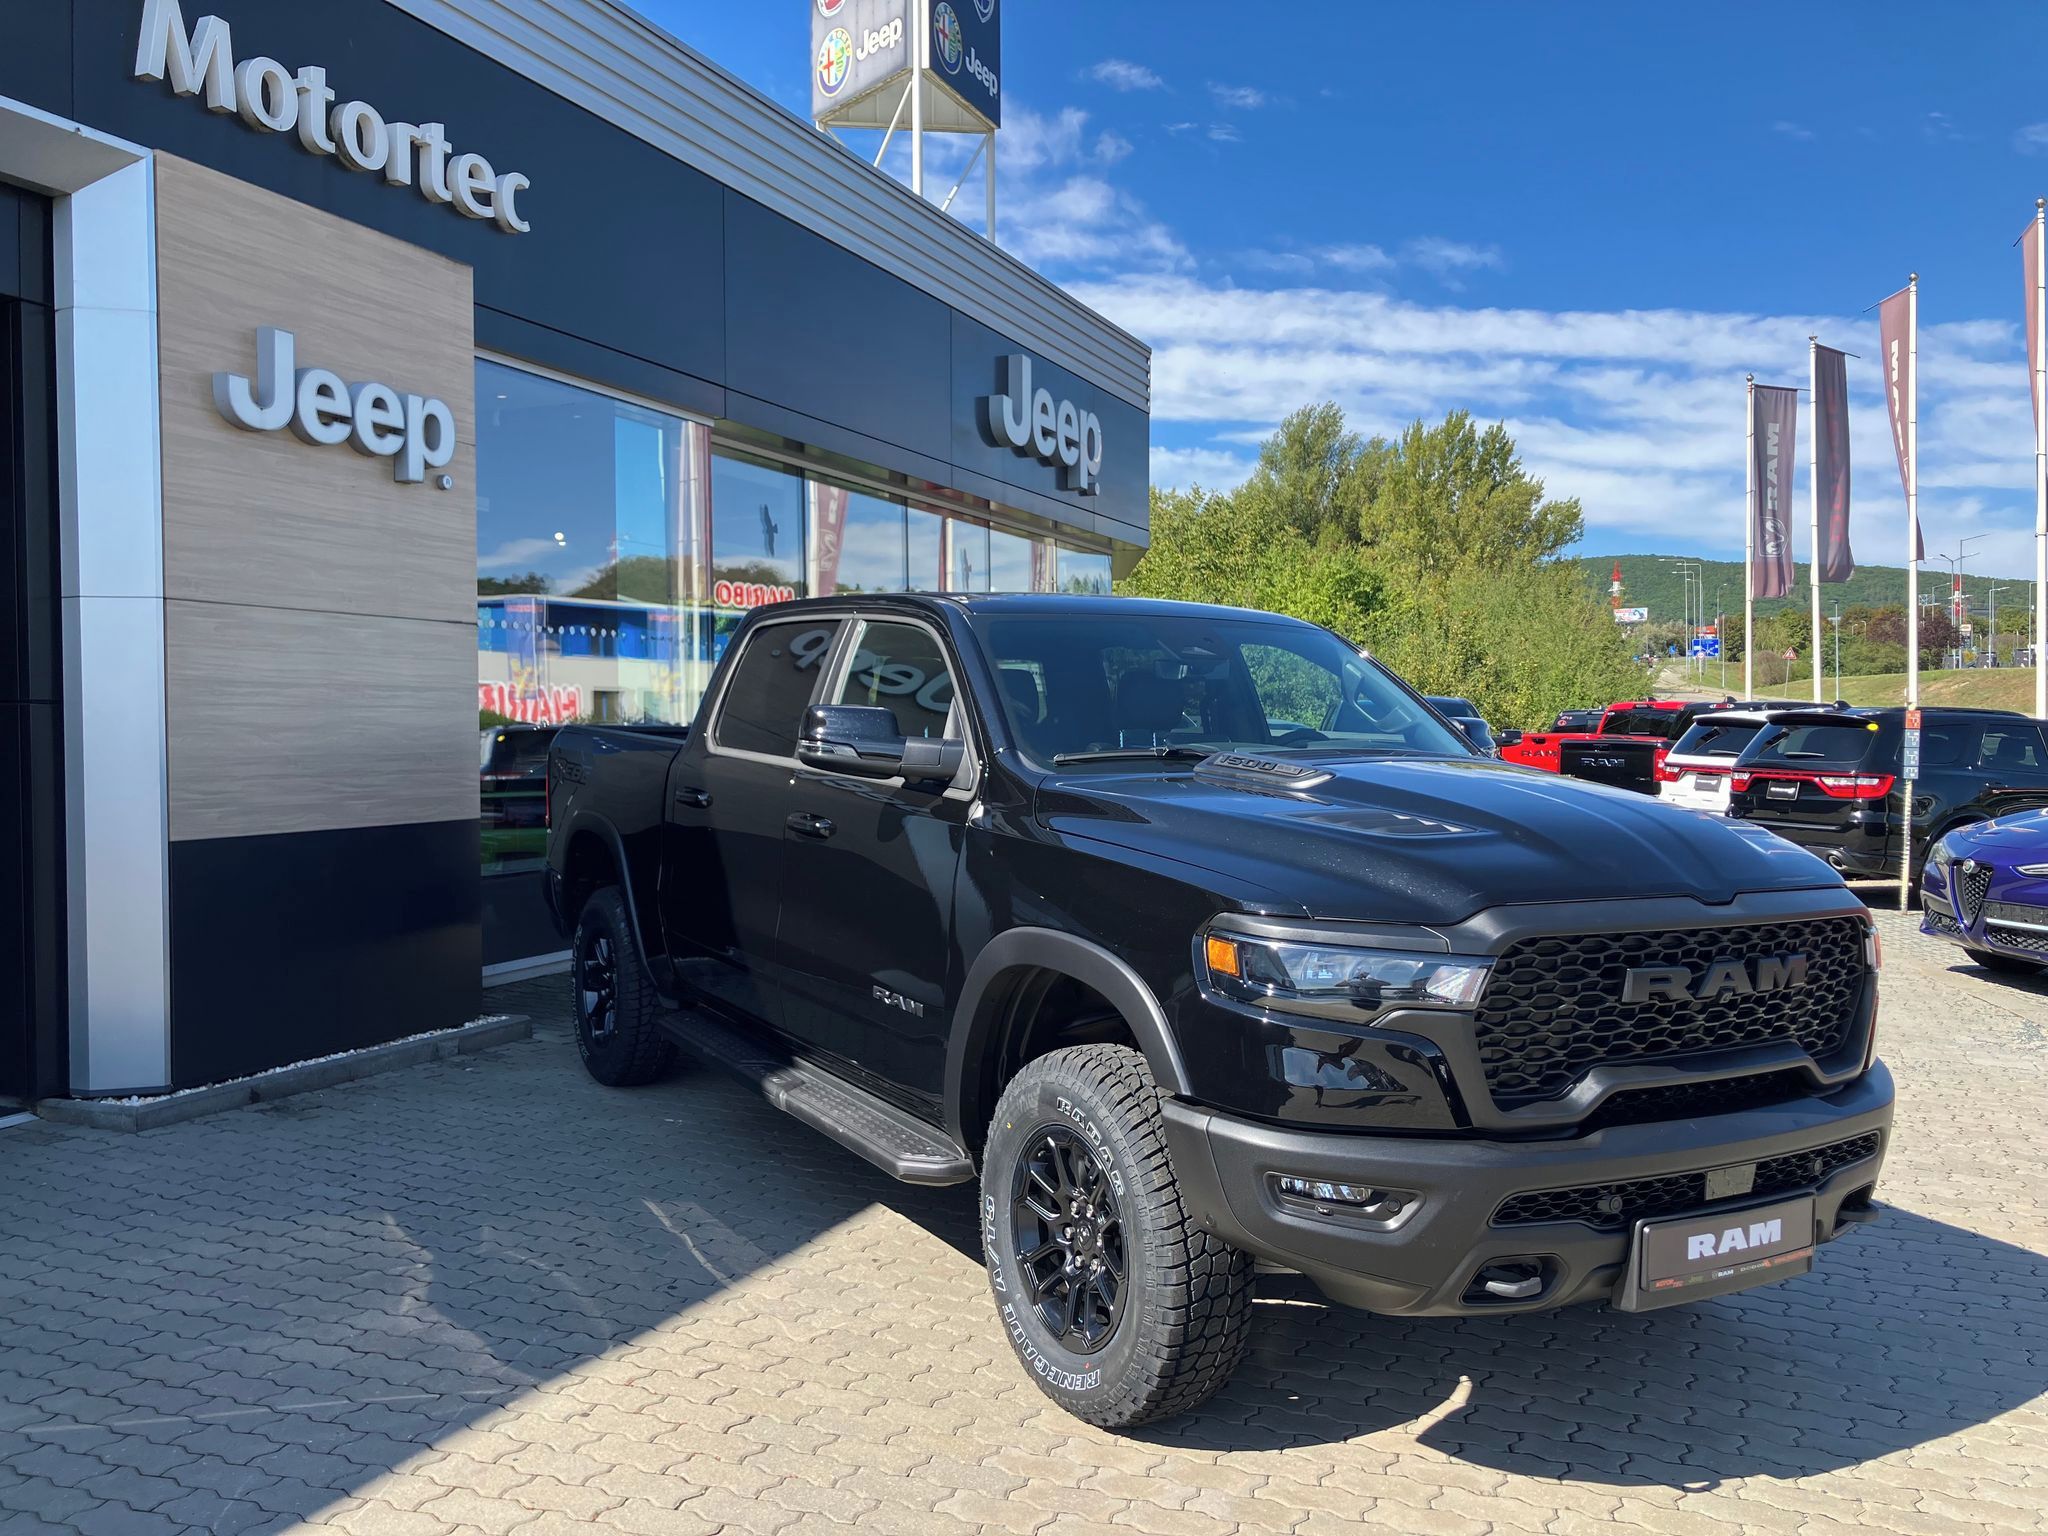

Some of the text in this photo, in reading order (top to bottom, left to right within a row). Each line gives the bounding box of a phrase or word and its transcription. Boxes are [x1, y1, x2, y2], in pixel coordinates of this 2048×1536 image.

[856, 17, 903, 61] Jeep
[965, 47, 998, 97] Jeep
[135, 0, 531, 234] Motortec
[212, 326, 456, 484] Jeep
[988, 353, 1102, 491] Jeep
[1766, 422, 1780, 511] RAM
[1221, 754, 1277, 771] 1500
[1580, 757, 1625, 768] RAM
[872, 985, 924, 1017] RAM
[1622, 952, 1807, 1003] RAM
[1056, 1096, 1124, 1196] RADAR
[1687, 1218, 1782, 1261] RAM
[1001, 1302, 1100, 1391] RENEGADE
